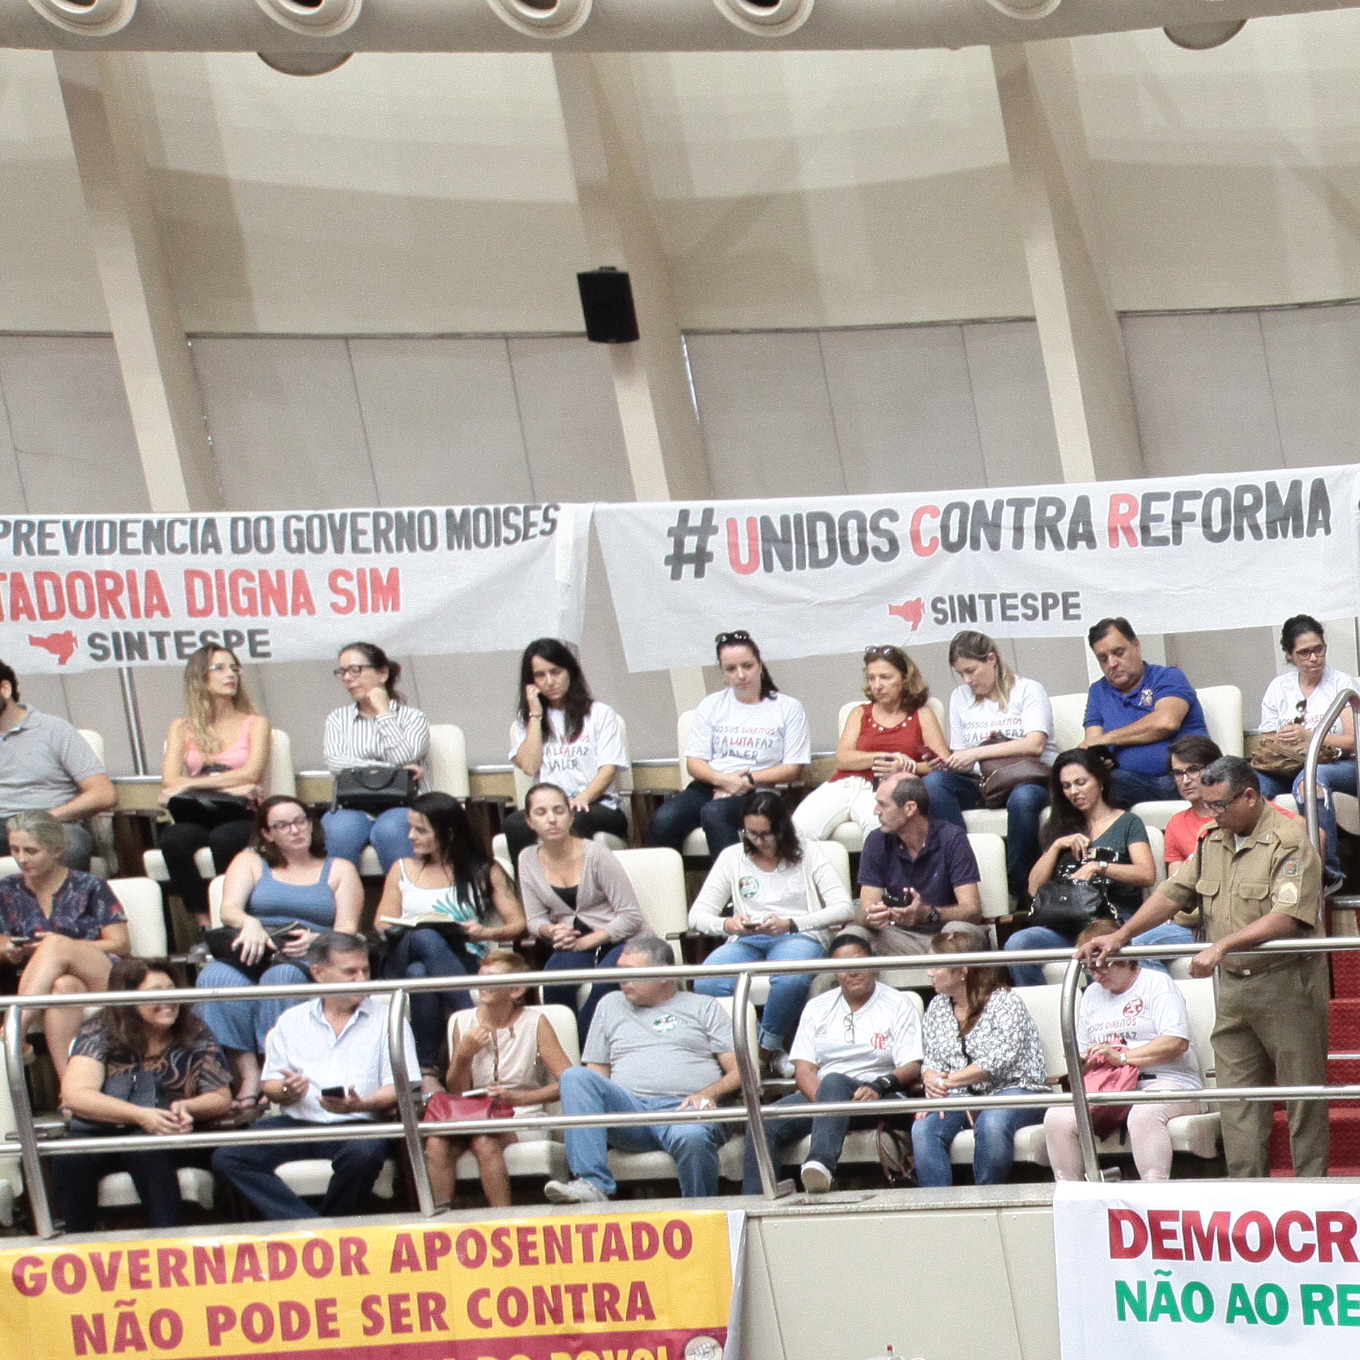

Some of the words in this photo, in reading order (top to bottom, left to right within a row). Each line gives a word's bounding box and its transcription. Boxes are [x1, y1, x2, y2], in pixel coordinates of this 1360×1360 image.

[230, 515, 274, 556] DO
[283, 509, 437, 556] GOVERNO
[445, 502, 561, 552] MOISES
[910, 493, 1097, 557] CONTRA
[1108, 478, 1332, 548] REFORMA
[184, 567, 316, 619] DIGNA
[328, 566, 402, 616] SIM
[931, 590, 1083, 625] SINTESPE
[571, 744, 590, 757] FAZ
[730, 737, 754, 747] LUTA
[755, 737, 774, 749] FAZ
[12, 1236, 370, 1298] GOVERNADOR
[389, 1218, 694, 1273] APOSENTADO
[71, 1299, 184, 1356] NÃO
[206, 1294, 341, 1347] PODE
[362, 1288, 449, 1338] SER
[467, 1280, 657, 1329] CONTRA
[1114, 1269, 1215, 1324] NÃO
[1225, 1282, 1290, 1326] AO
